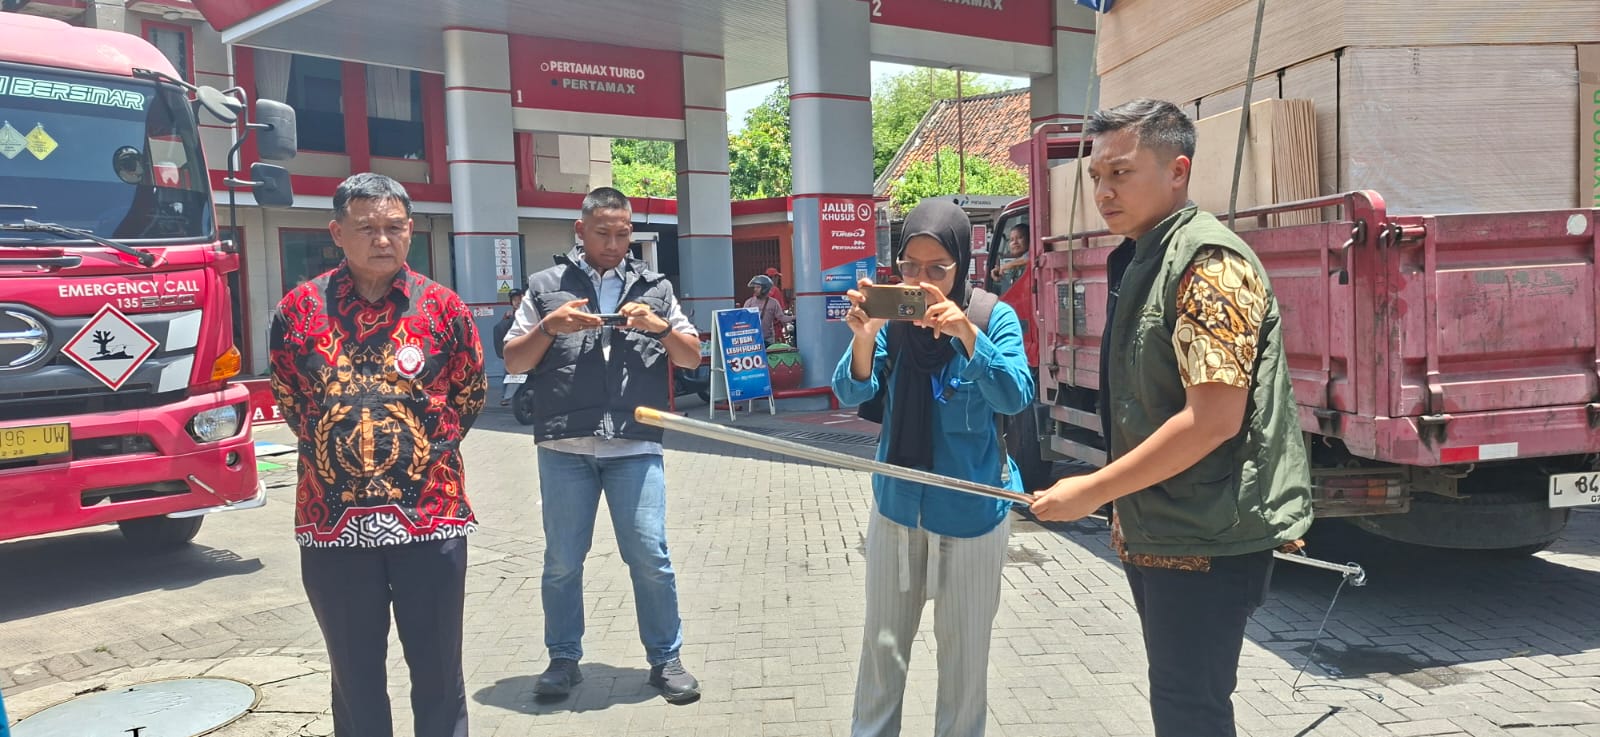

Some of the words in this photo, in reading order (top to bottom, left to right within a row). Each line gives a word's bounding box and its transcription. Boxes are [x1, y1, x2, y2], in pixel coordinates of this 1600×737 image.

[550, 60, 608, 77] PERTAMAX
[609, 66, 645, 80] TURBO
[562, 78, 636, 95] PERTAMAX
[517, 89, 523, 103] 1
[822, 202, 855, 213] JALUR
[822, 213, 856, 221] KHUSUS
[58, 281, 159, 298] EMERGENCY
[164, 280, 200, 293] CALL
[117, 298, 139, 309] 135
[731, 355, 762, 372] 300
[1553, 477, 1563, 496] L
